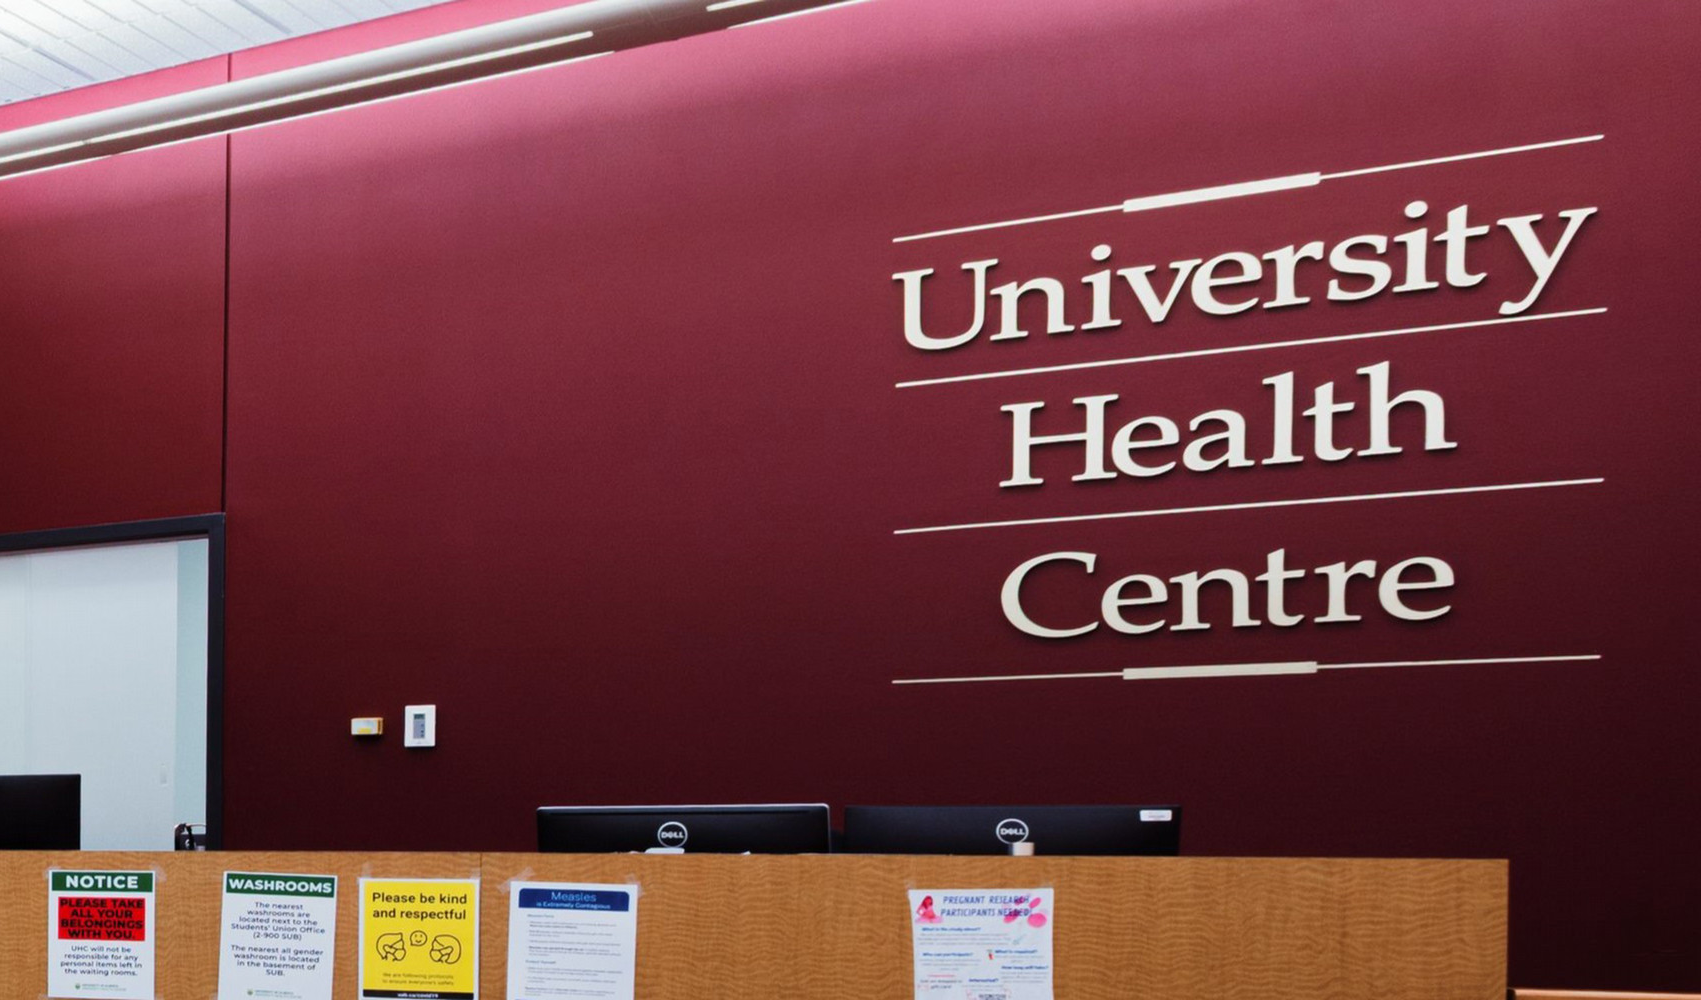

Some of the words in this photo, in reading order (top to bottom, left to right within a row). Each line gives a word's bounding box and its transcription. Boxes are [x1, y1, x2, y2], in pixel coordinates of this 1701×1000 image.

[892, 200, 1599, 351] University
[1000, 361, 1457, 487] Health
[1000, 548, 1455, 639] Centre
[661, 831, 683, 839] DELL
[66, 875, 138, 888] NOTICE
[228, 879, 332, 893] WASHROOMS
[373, 892, 415, 903] Please
[420, 893, 435, 903] be
[440, 894, 467, 904] kind
[551, 892, 597, 902] Measles
[943, 896, 985, 904] PREGNANT
[989, 896, 1029, 904] RESEARCH
[60, 899, 106, 908] PLEASE
[112, 900, 144, 908] TAKE
[71, 909, 94, 918] ALL
[98, 909, 133, 918] YOUR
[373, 908, 396, 918] and
[400, 909, 466, 921] respectful
[61, 919, 143, 929] BELONGINGS
[68, 929, 101, 937] WITH
